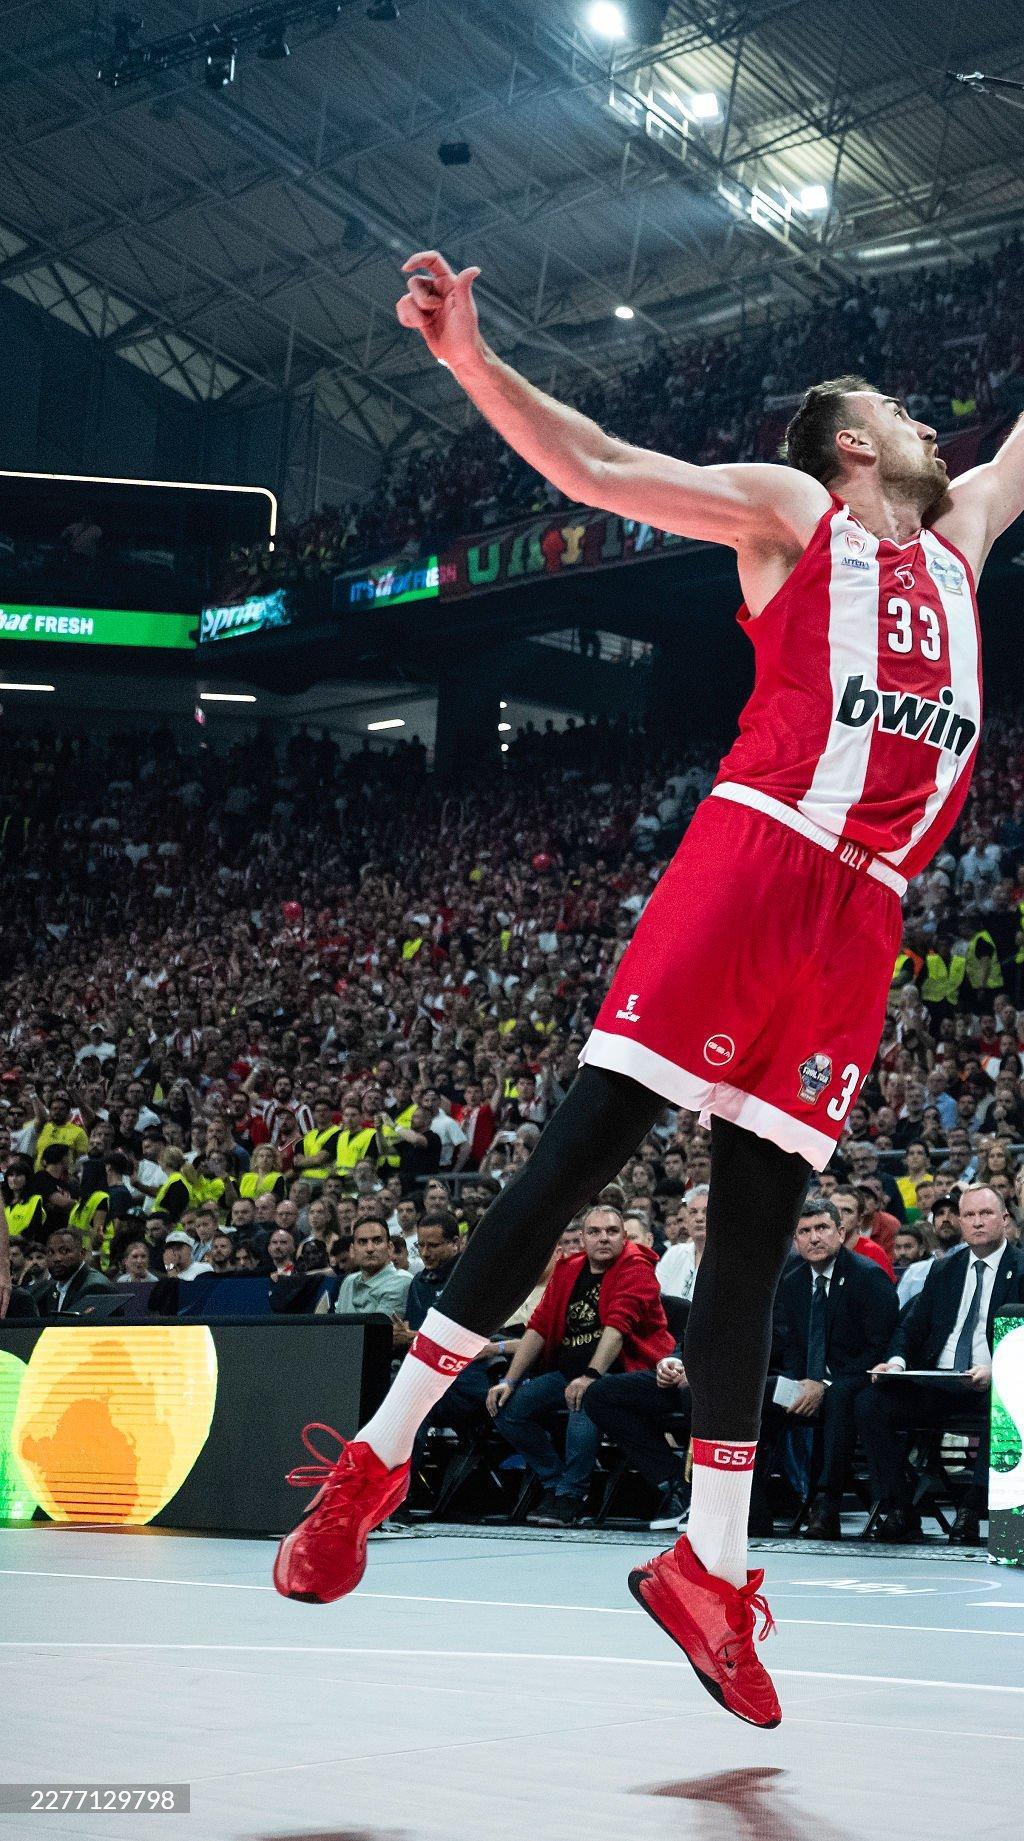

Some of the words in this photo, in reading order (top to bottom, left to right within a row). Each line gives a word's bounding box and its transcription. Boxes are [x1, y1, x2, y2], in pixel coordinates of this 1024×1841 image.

[34, 615, 94, 636] FRESH
[887, 597, 941, 661] 33
[836, 675, 976, 757] bwin
[827, 1063, 868, 1122] 3
